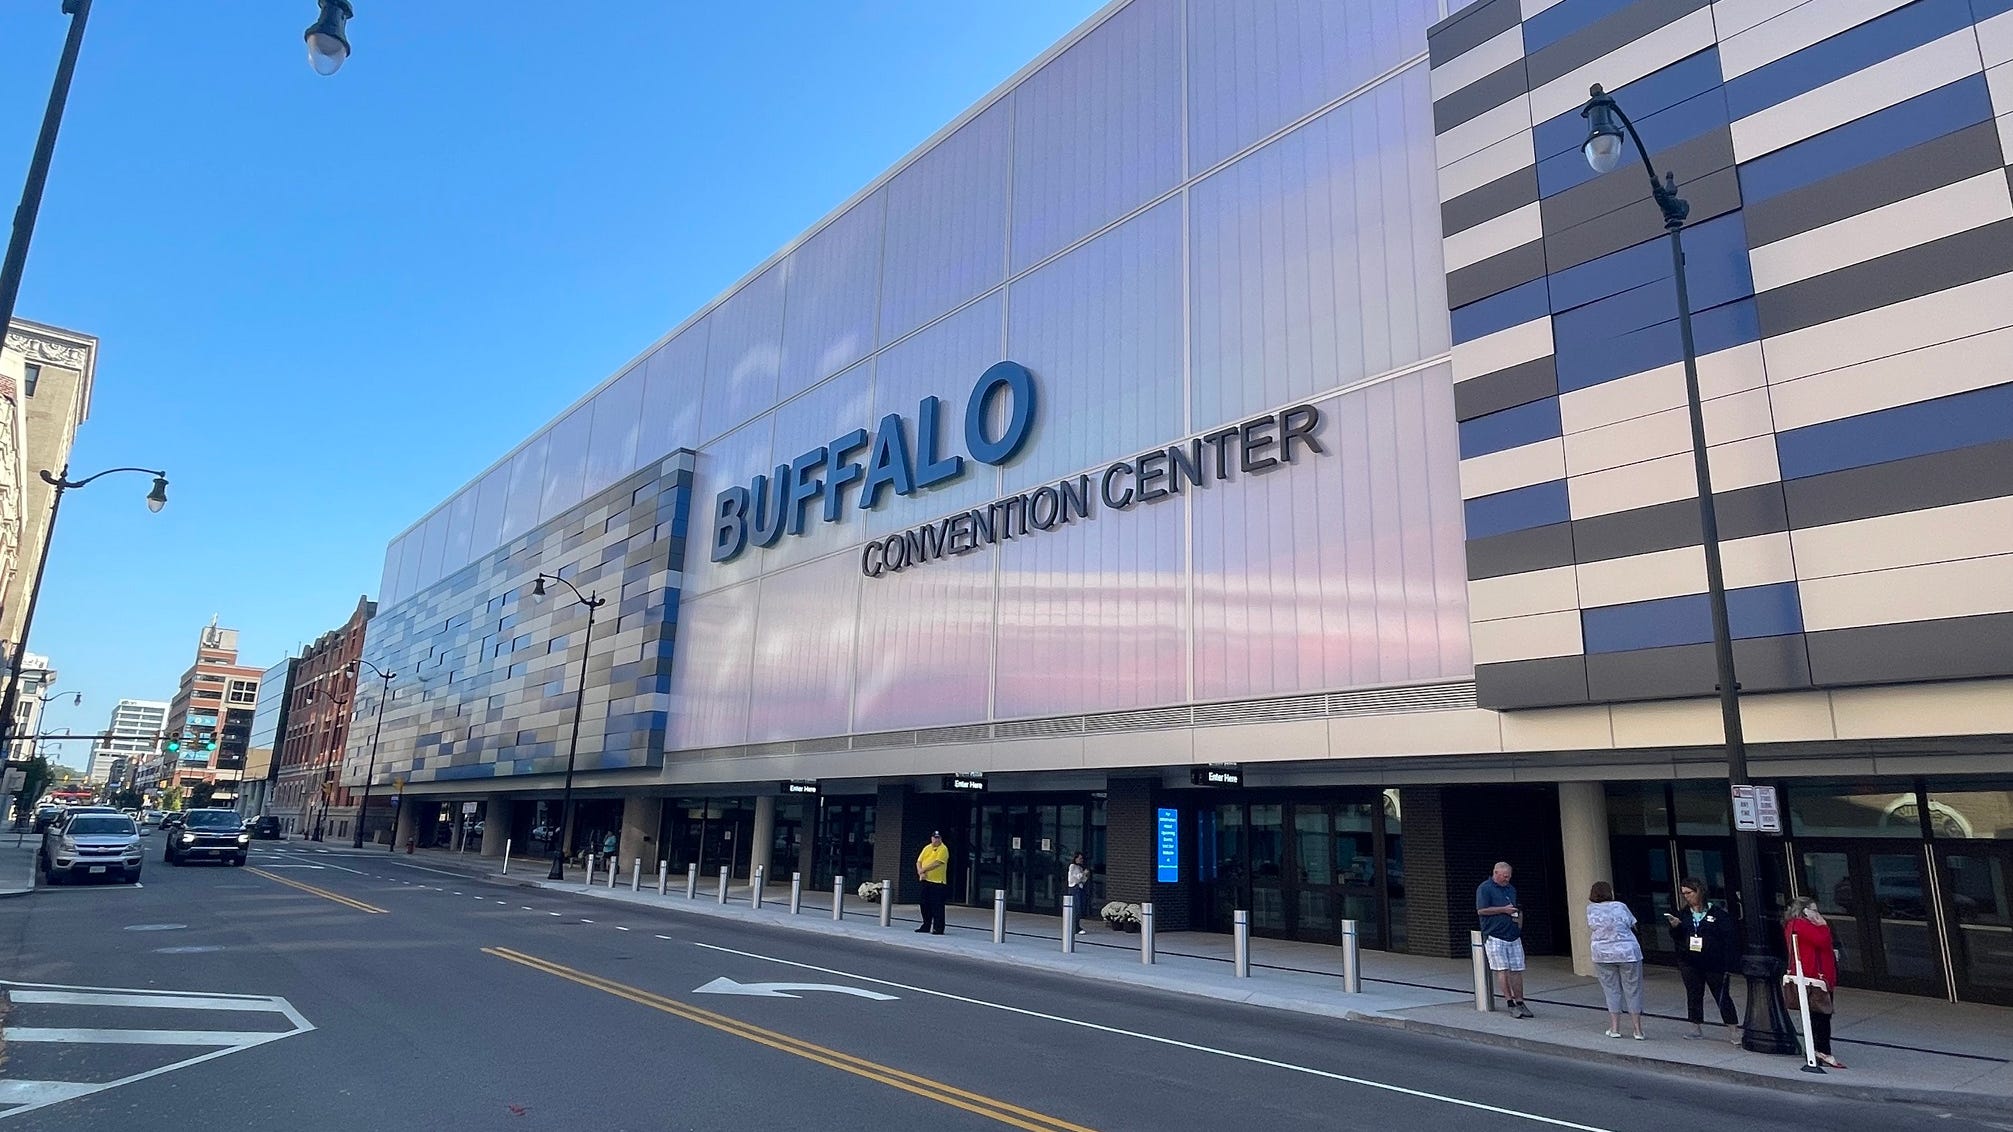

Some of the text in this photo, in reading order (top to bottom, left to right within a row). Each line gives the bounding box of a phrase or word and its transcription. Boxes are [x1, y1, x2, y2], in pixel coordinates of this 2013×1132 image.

[711, 361, 1036, 562] BUFFALO
[862, 404, 1324, 578] CONVENTION CENTER
[1208, 771, 1238, 783] Enter Here
[789, 784, 817, 793] Enter Here
[954, 779, 983, 789] Enter Here
